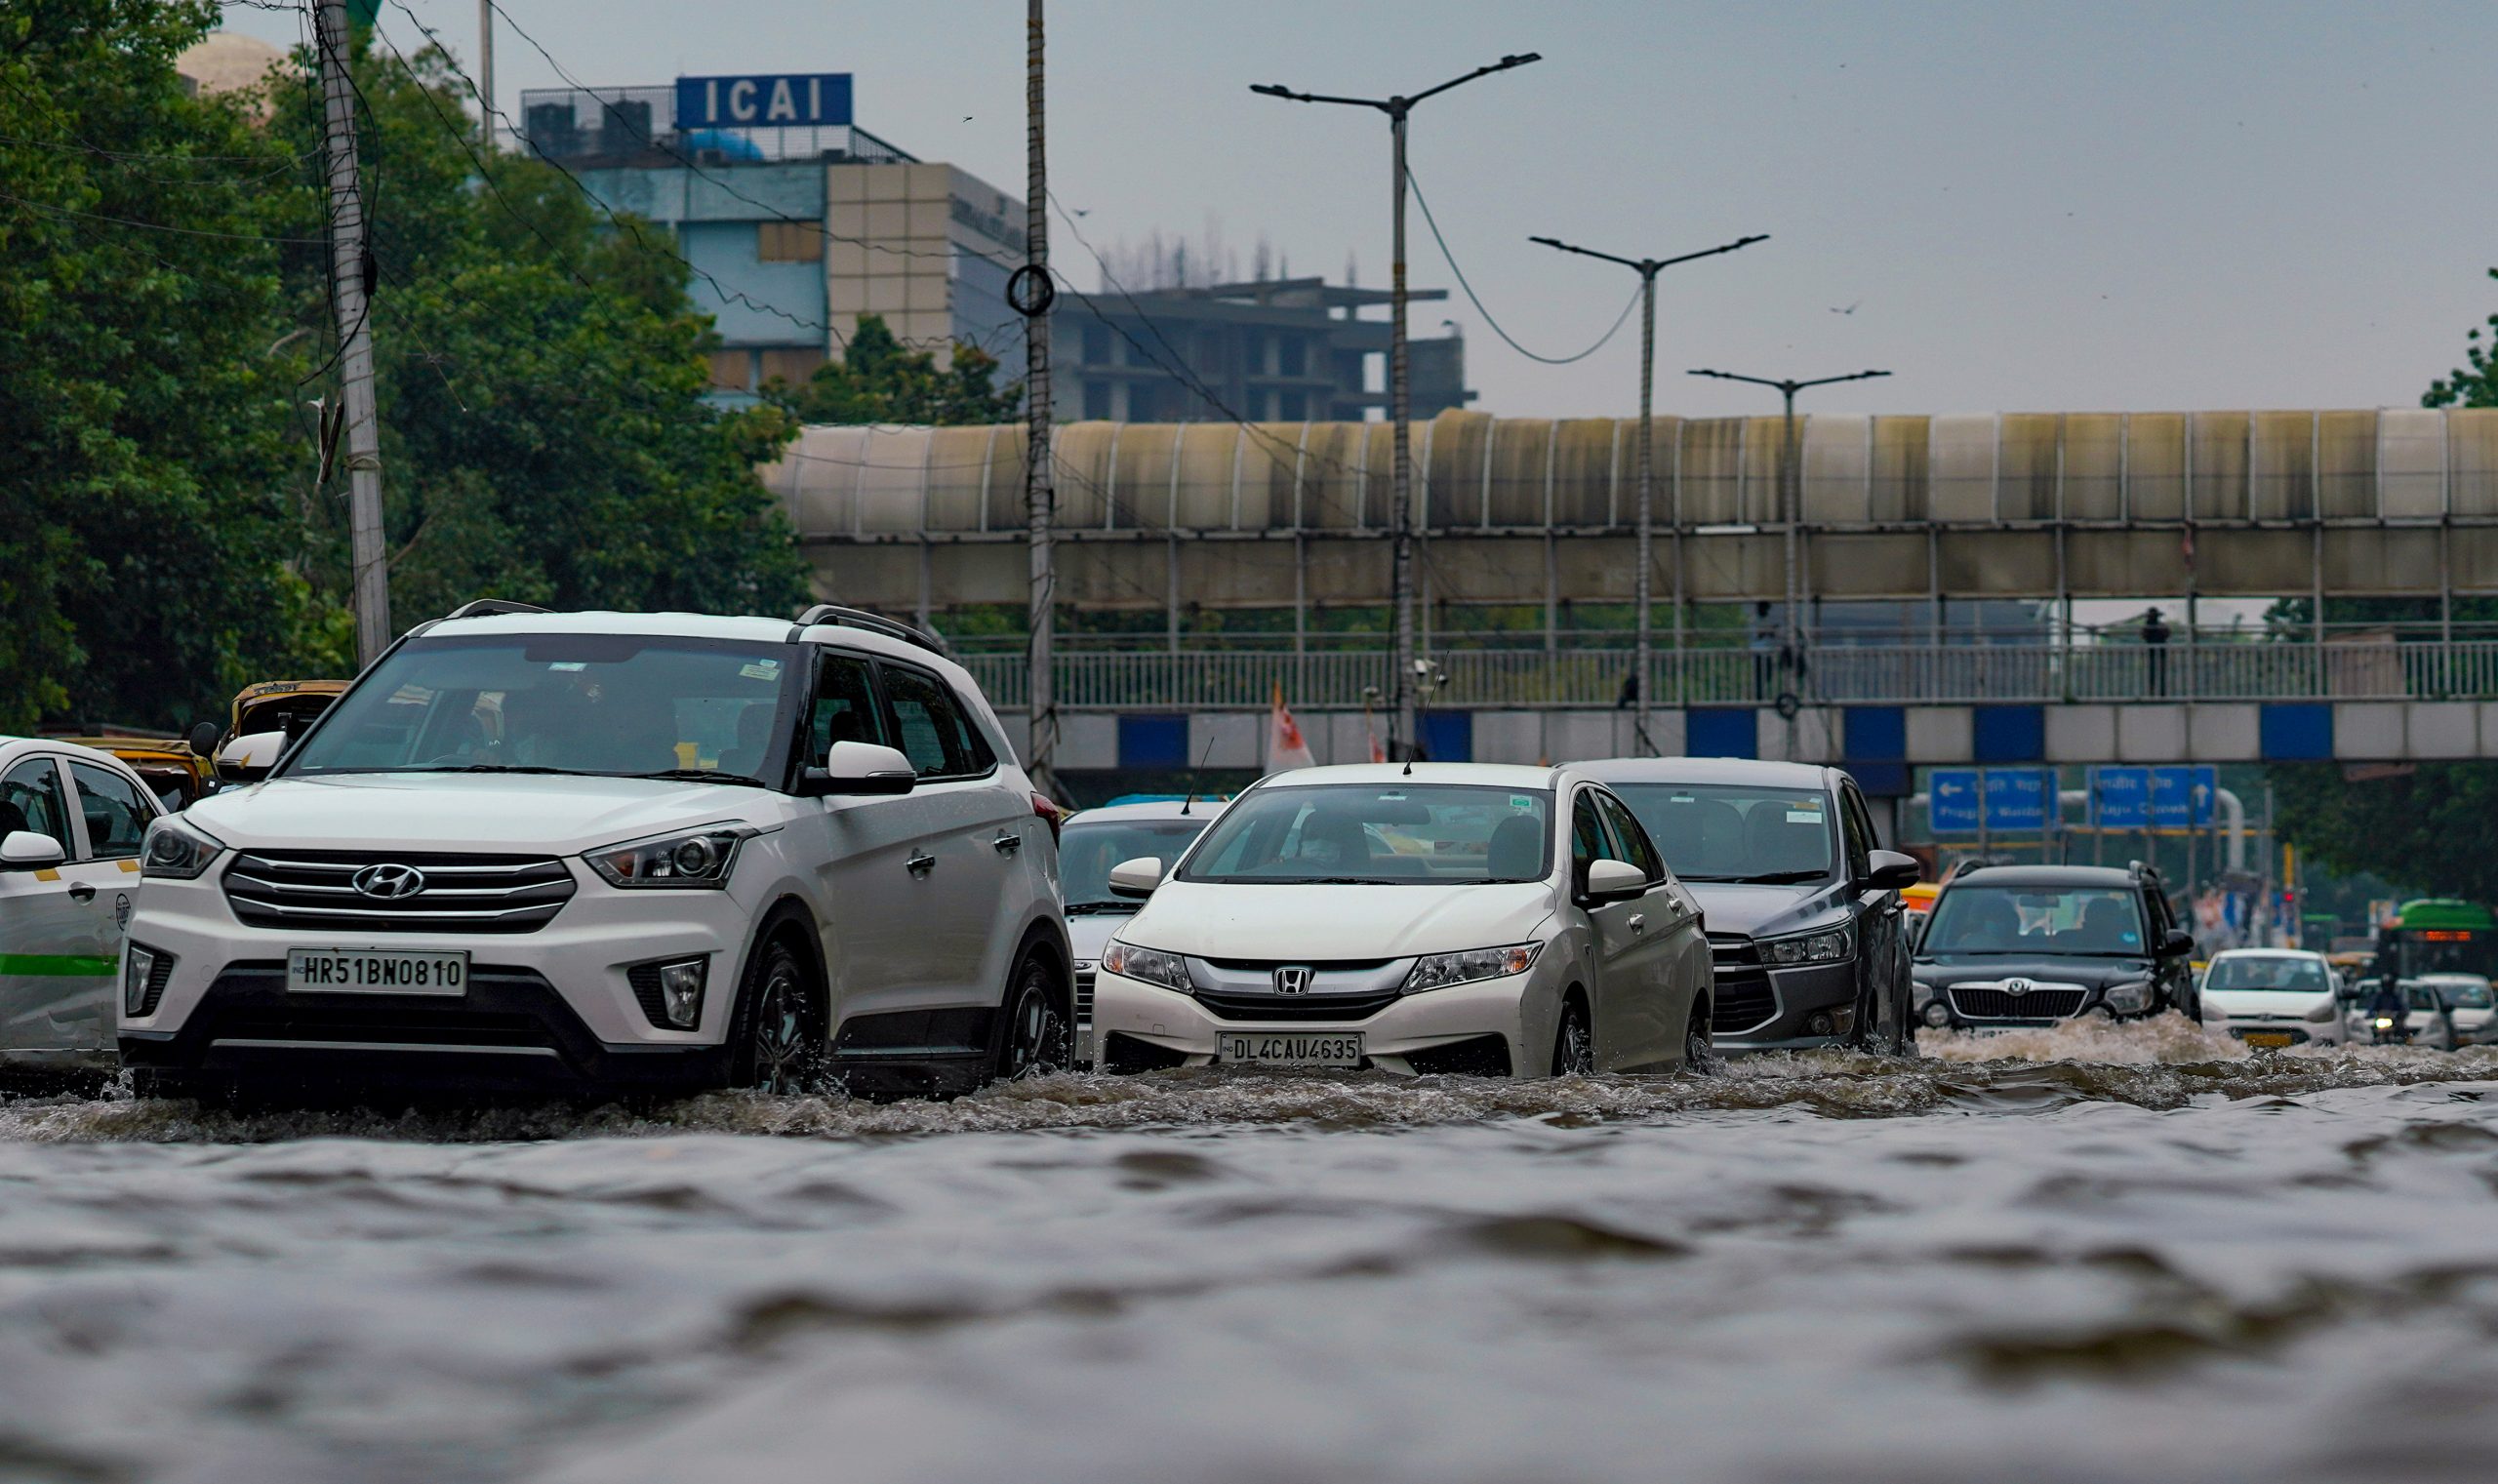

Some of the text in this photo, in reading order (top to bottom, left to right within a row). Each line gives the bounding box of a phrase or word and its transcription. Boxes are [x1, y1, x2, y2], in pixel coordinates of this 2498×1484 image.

[705, 78, 822, 123] ICAI
[304, 957, 461, 986] HR51BN0810
[1234, 1039, 1356, 1059] DL4CAU4635
